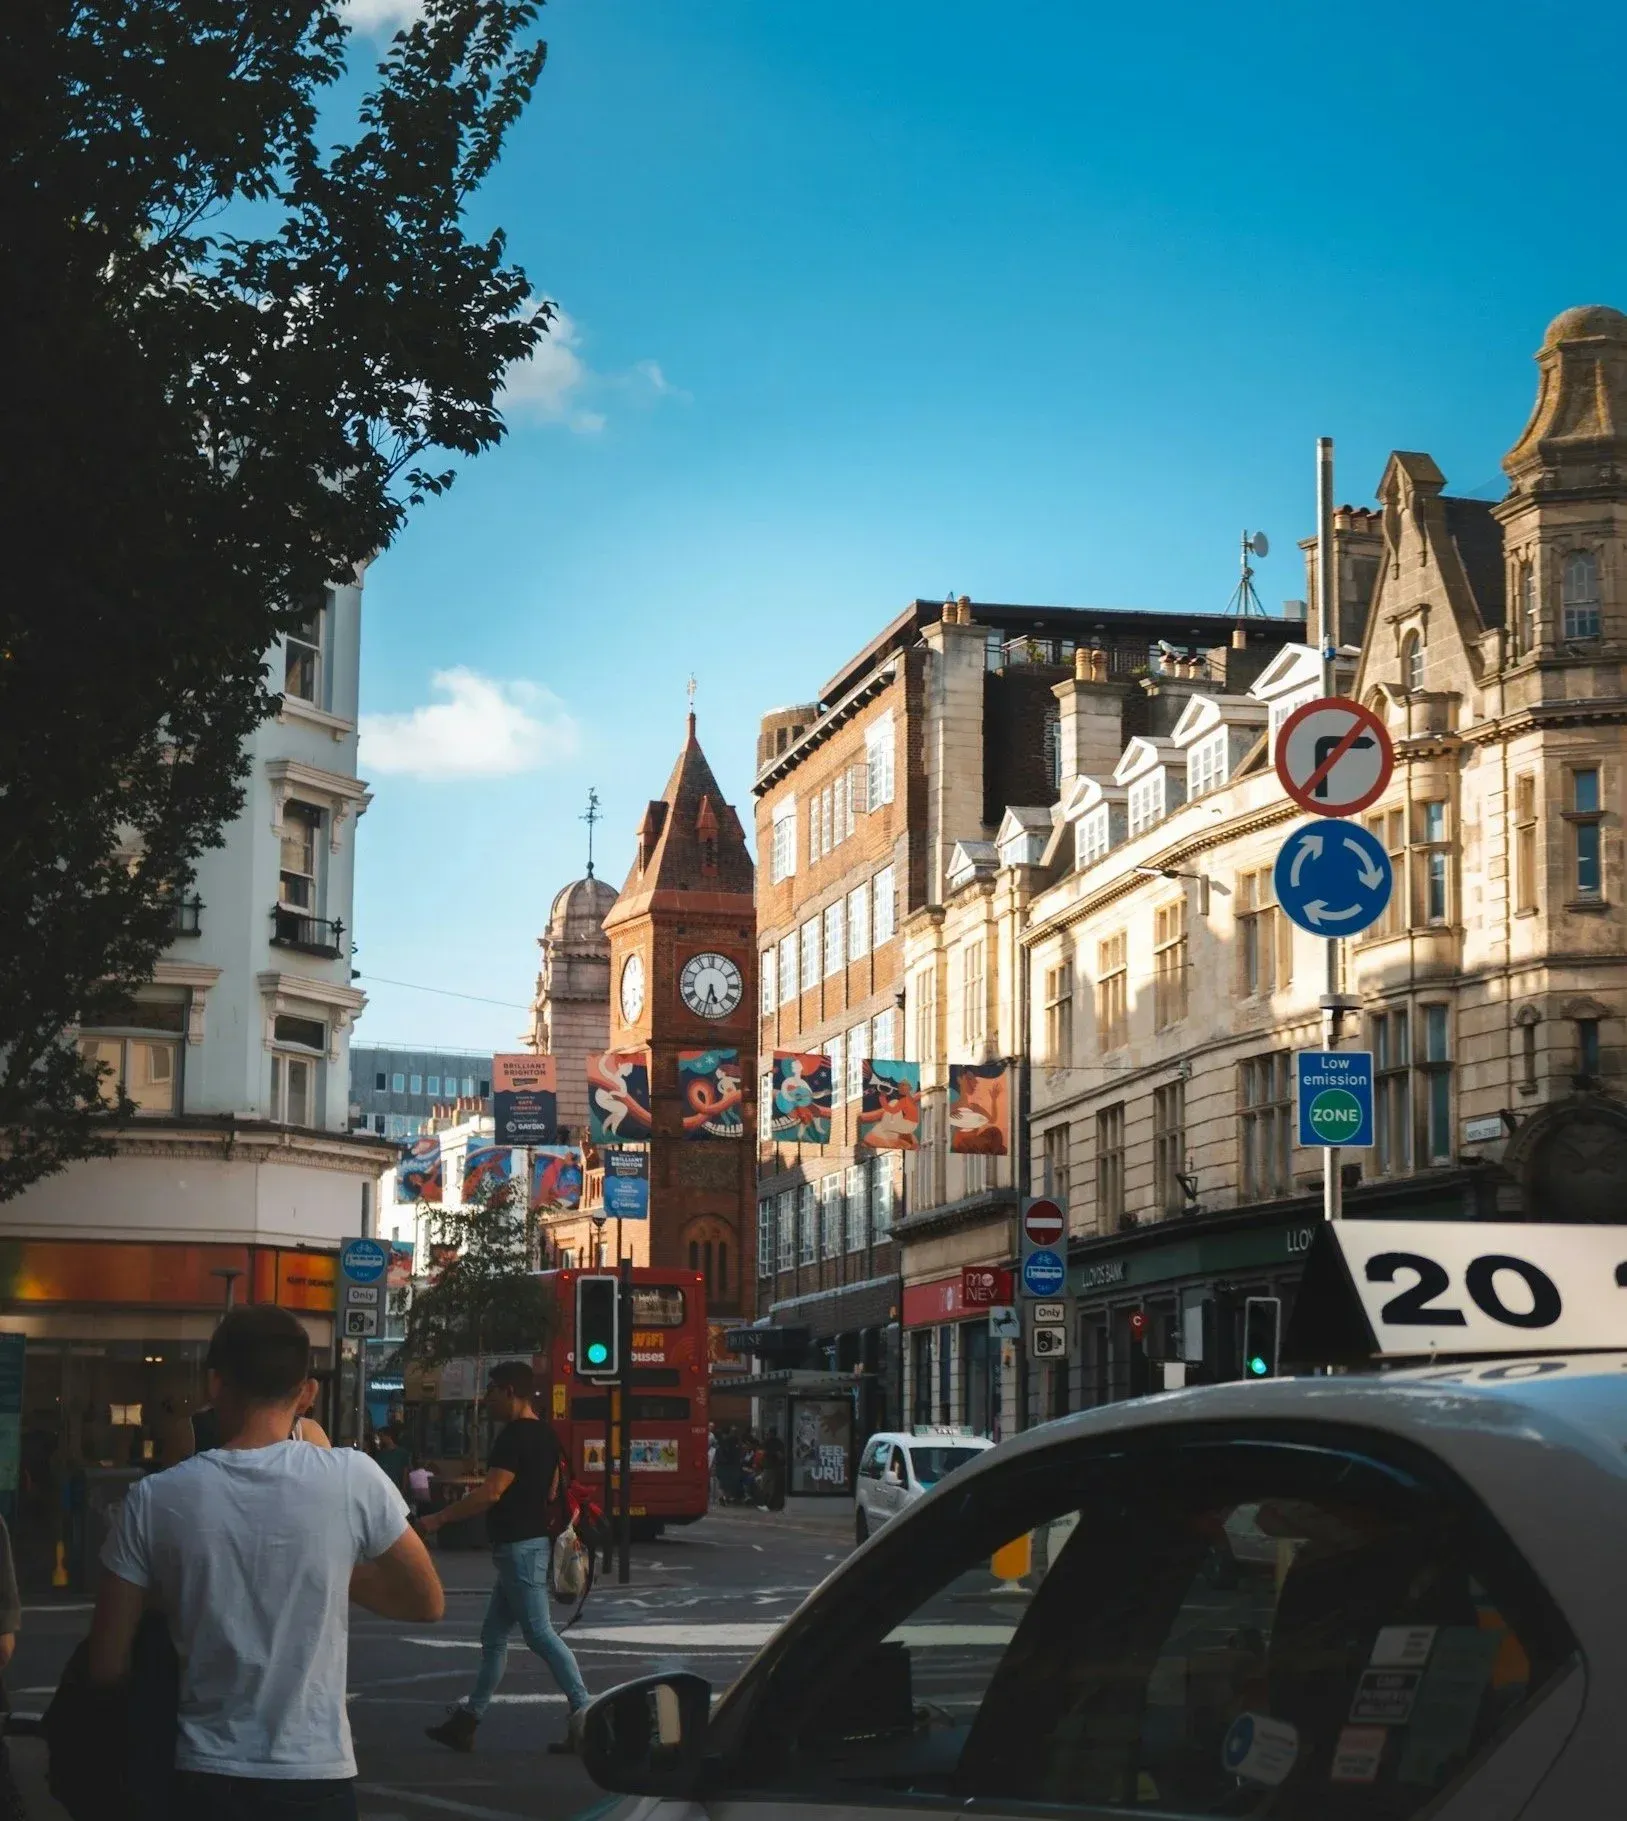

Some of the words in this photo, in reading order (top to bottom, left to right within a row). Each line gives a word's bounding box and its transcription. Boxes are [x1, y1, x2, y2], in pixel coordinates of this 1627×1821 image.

[503, 1062, 546, 1070] BRILLIANT
[1321, 1056, 1349, 1069] Low
[1303, 1073, 1367, 1086] emission
[1313, 1108, 1358, 1122] ZONE
[352, 1290, 374, 1301] Only
[1365, 1252, 1563, 1329] 20
[1038, 1307, 1060, 1318] Only
[819, 1445, 848, 1457] FEEL
[821, 1456, 845, 1467] THE
